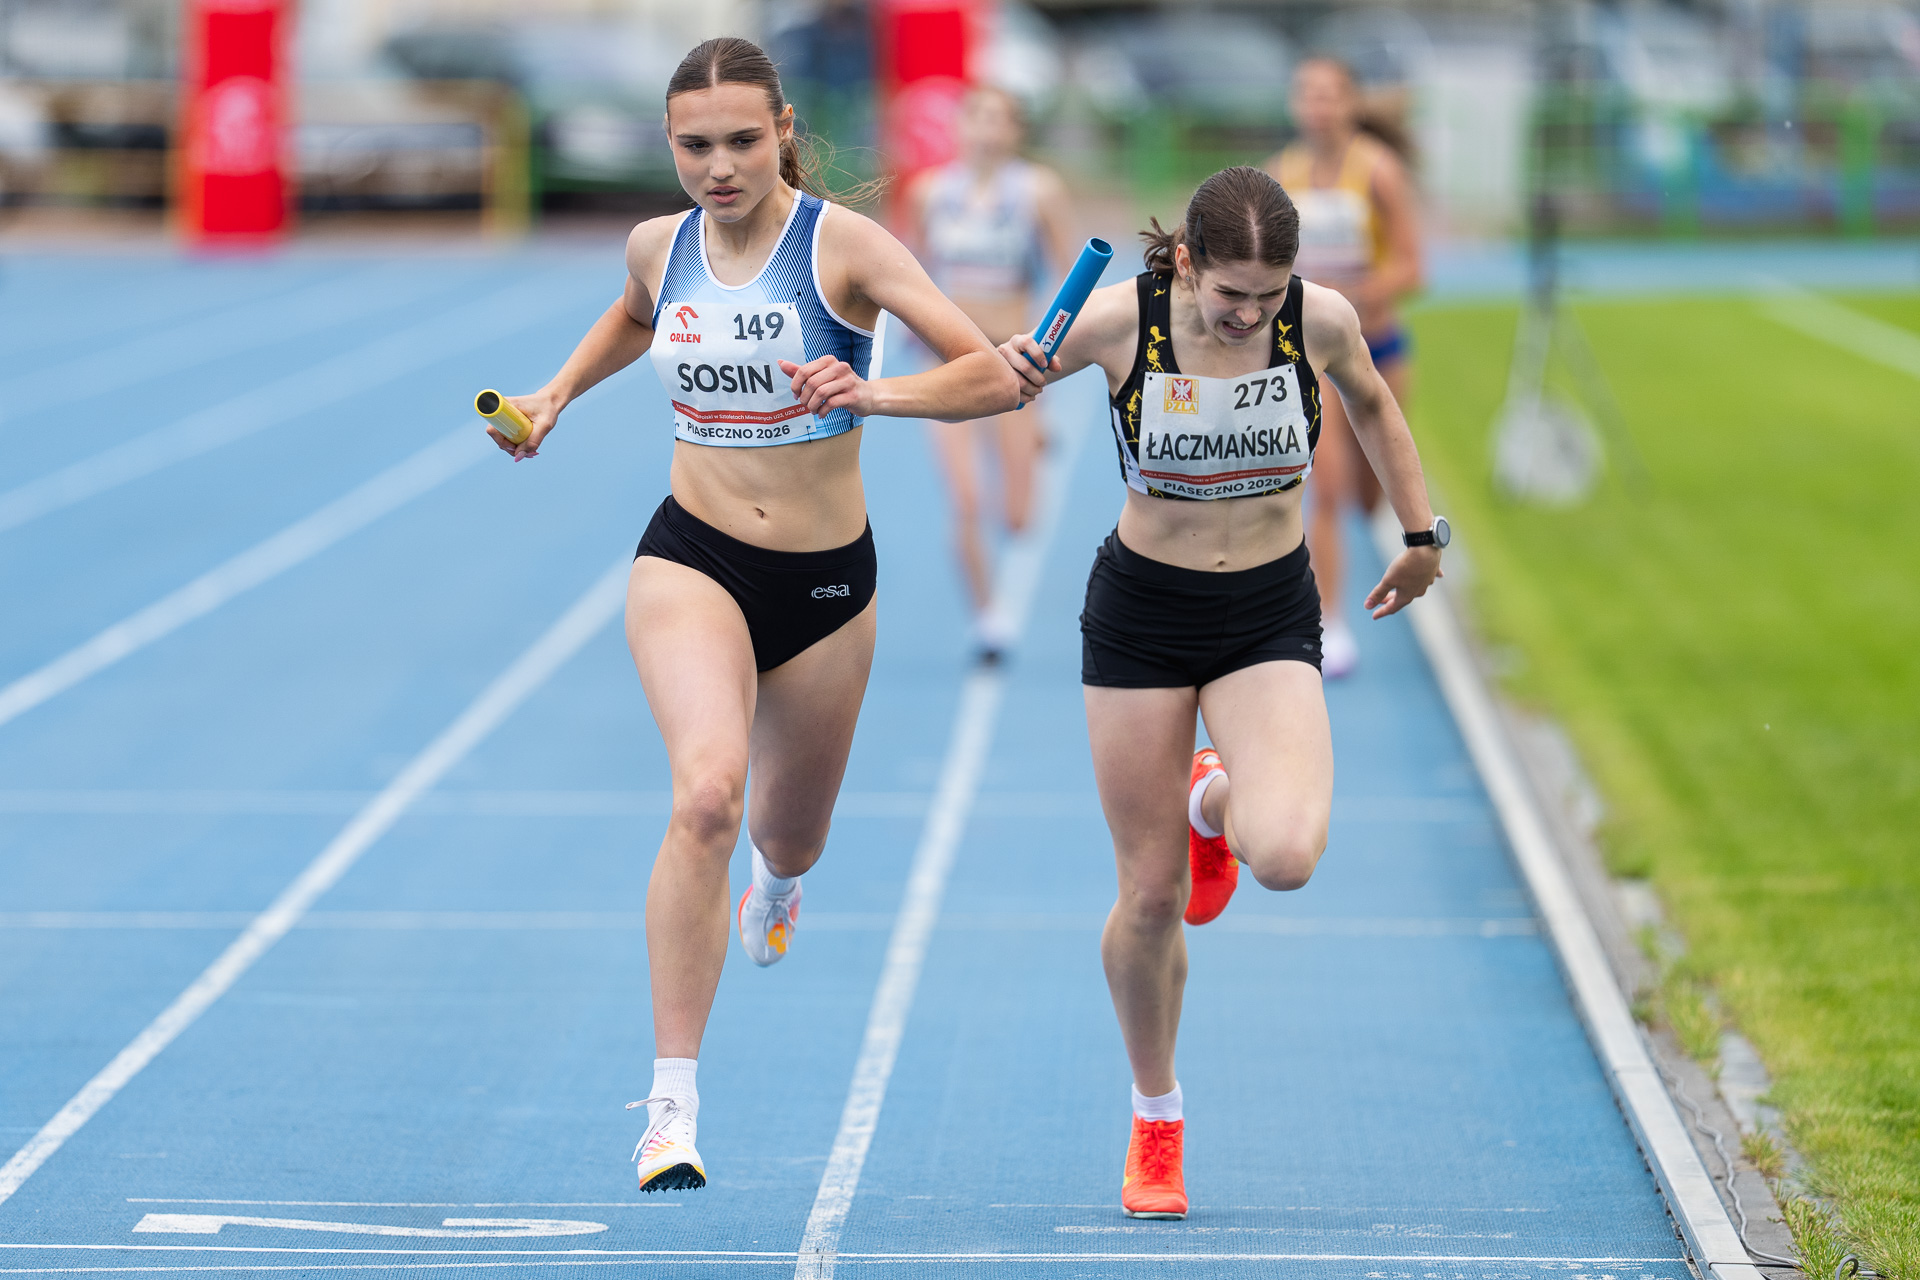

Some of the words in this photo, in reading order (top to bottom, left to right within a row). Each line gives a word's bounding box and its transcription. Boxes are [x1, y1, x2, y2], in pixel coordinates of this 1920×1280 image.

[670, 332, 702, 344] ORLEN
[733, 311, 785, 341] 149
[1048, 313, 1067, 342] polanik
[677, 362, 774, 394] SOSIN
[1233, 375, 1288, 411] 273
[1166, 401, 1197, 413] PZLA
[687, 421, 754, 440] PIASECZNO
[756, 424, 791, 440] 2026
[1146, 424, 1302, 461] ŁACZMAŃSKA
[1163, 480, 1245, 497] PIASECZNO
[1247, 477, 1283, 491] 2026
[811, 584, 851, 599] esa
